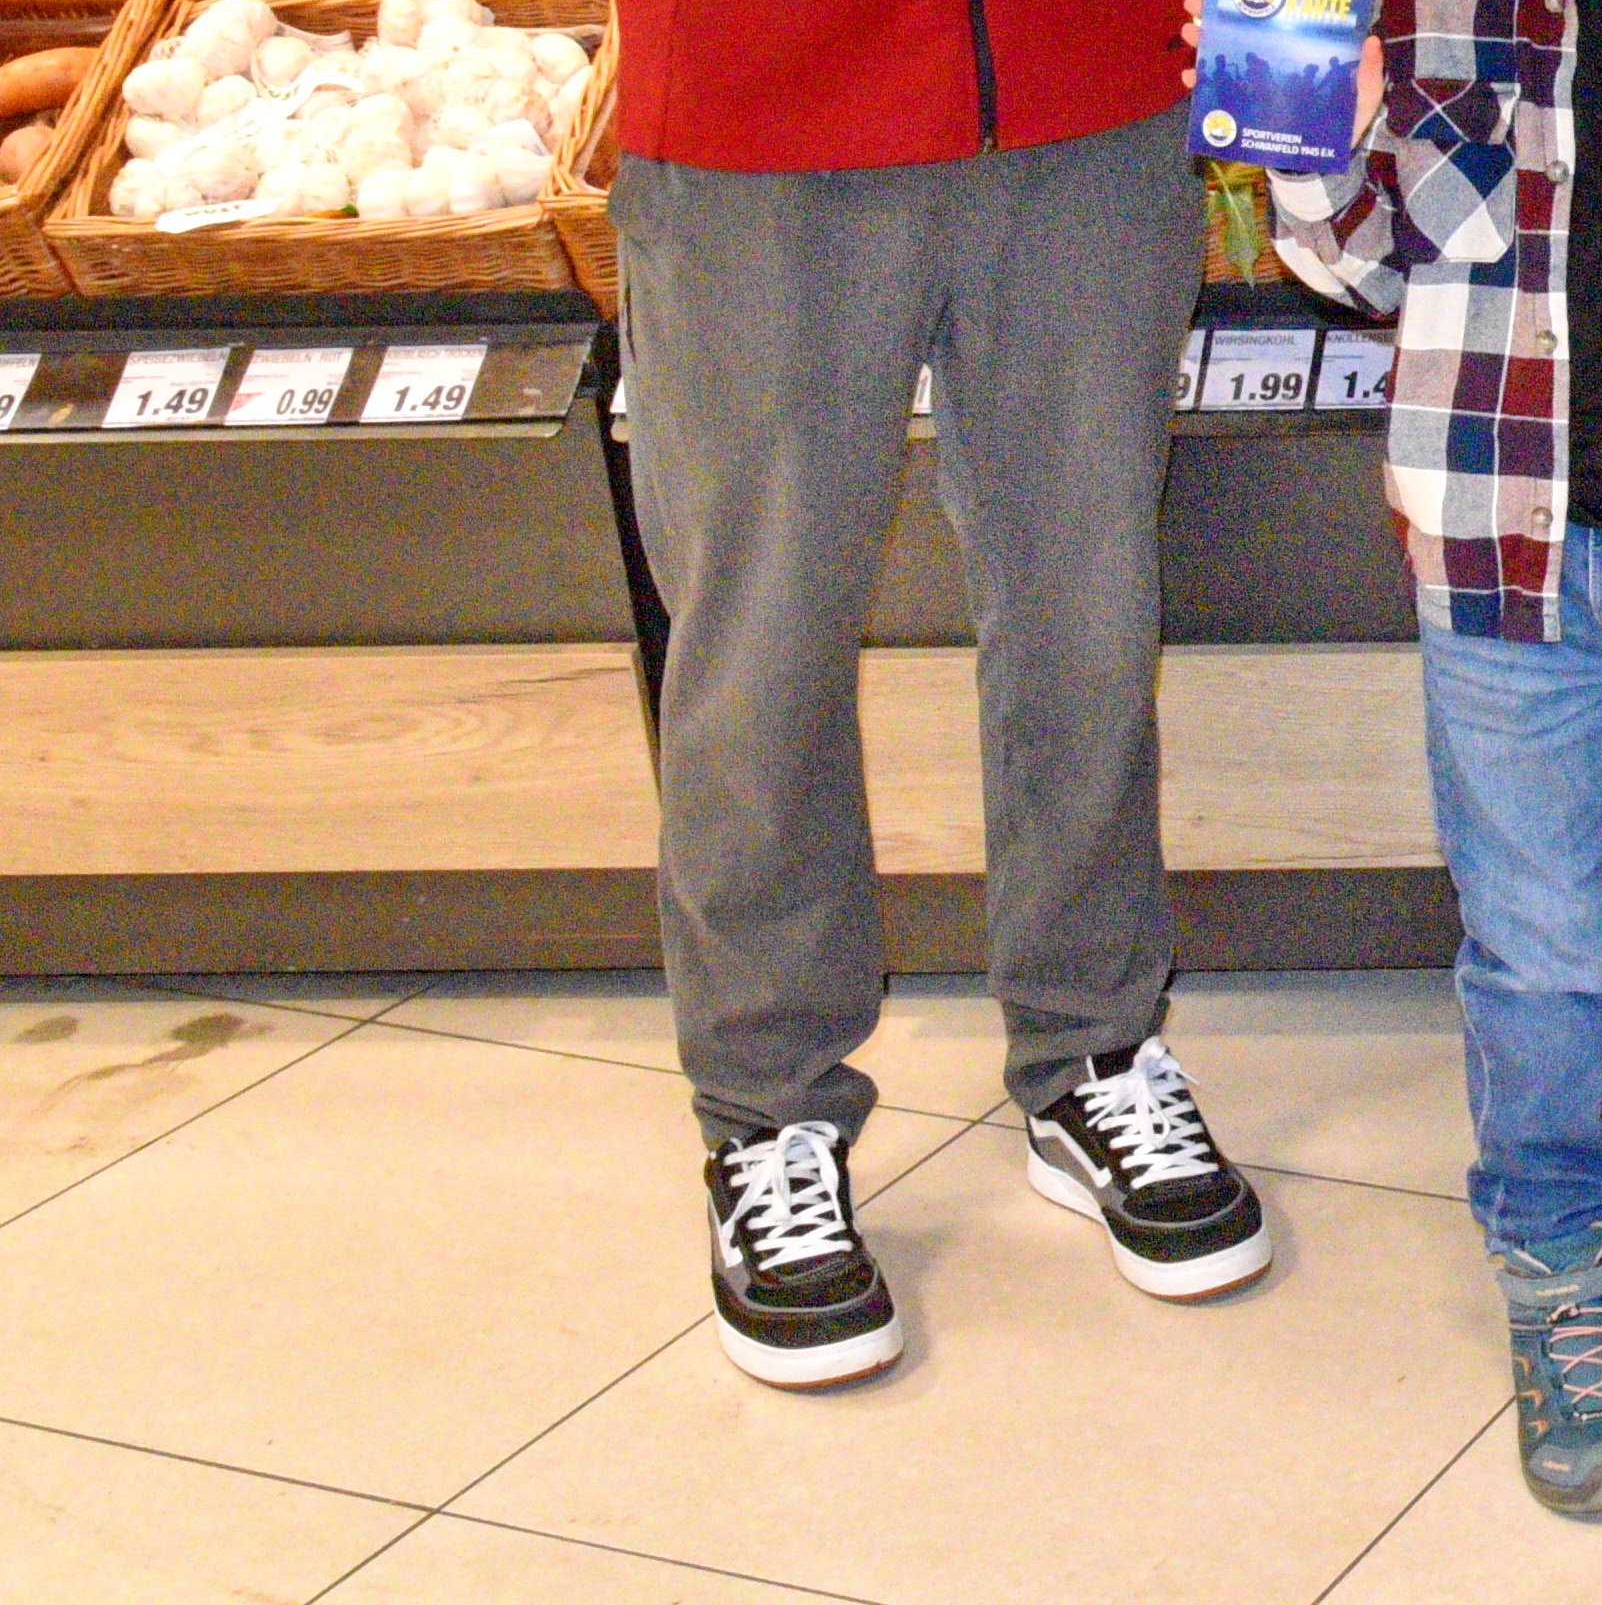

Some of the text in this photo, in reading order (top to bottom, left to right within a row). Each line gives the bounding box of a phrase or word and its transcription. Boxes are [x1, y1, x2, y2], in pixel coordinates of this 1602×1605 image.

[1242, 128, 1302, 145] SPORTVEREIN
[1214, 334, 1296, 346] WIRSINGKOHL
[394, 385, 467, 412] 1.49
[1230, 372, 1303, 401] 1.99
[137, 387, 209, 416] 1.49
[276, 388, 334, 415] 0.99
